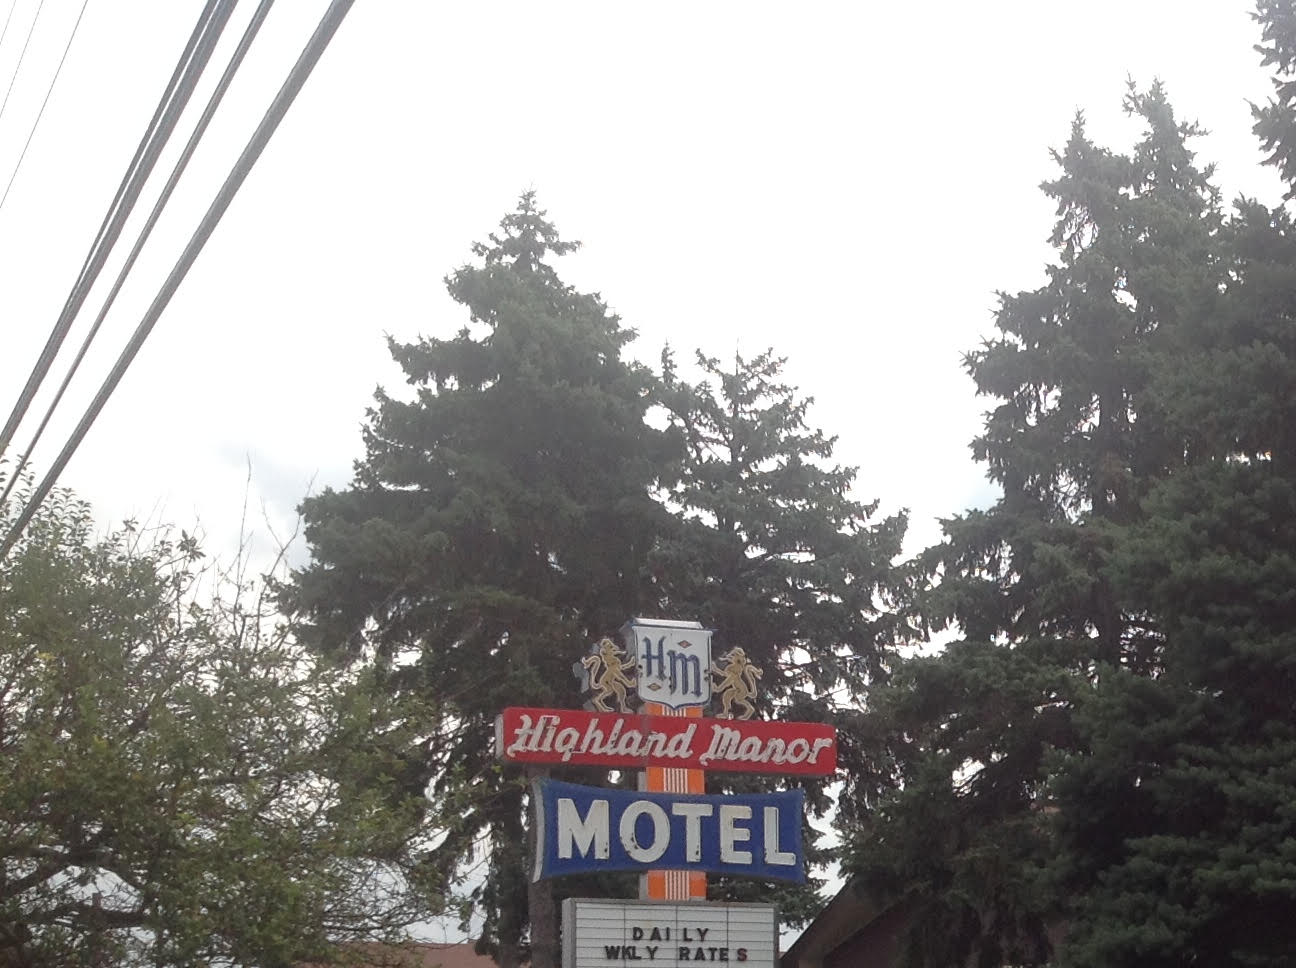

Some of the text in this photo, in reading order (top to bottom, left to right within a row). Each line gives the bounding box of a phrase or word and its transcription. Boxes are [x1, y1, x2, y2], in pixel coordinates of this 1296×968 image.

[507, 715, 832, 765] Highland Manor
[558, 798, 797, 866] MOTEL
[632, 926, 709, 942] DAILY
[604, 945, 748, 962] WKLY RATES
